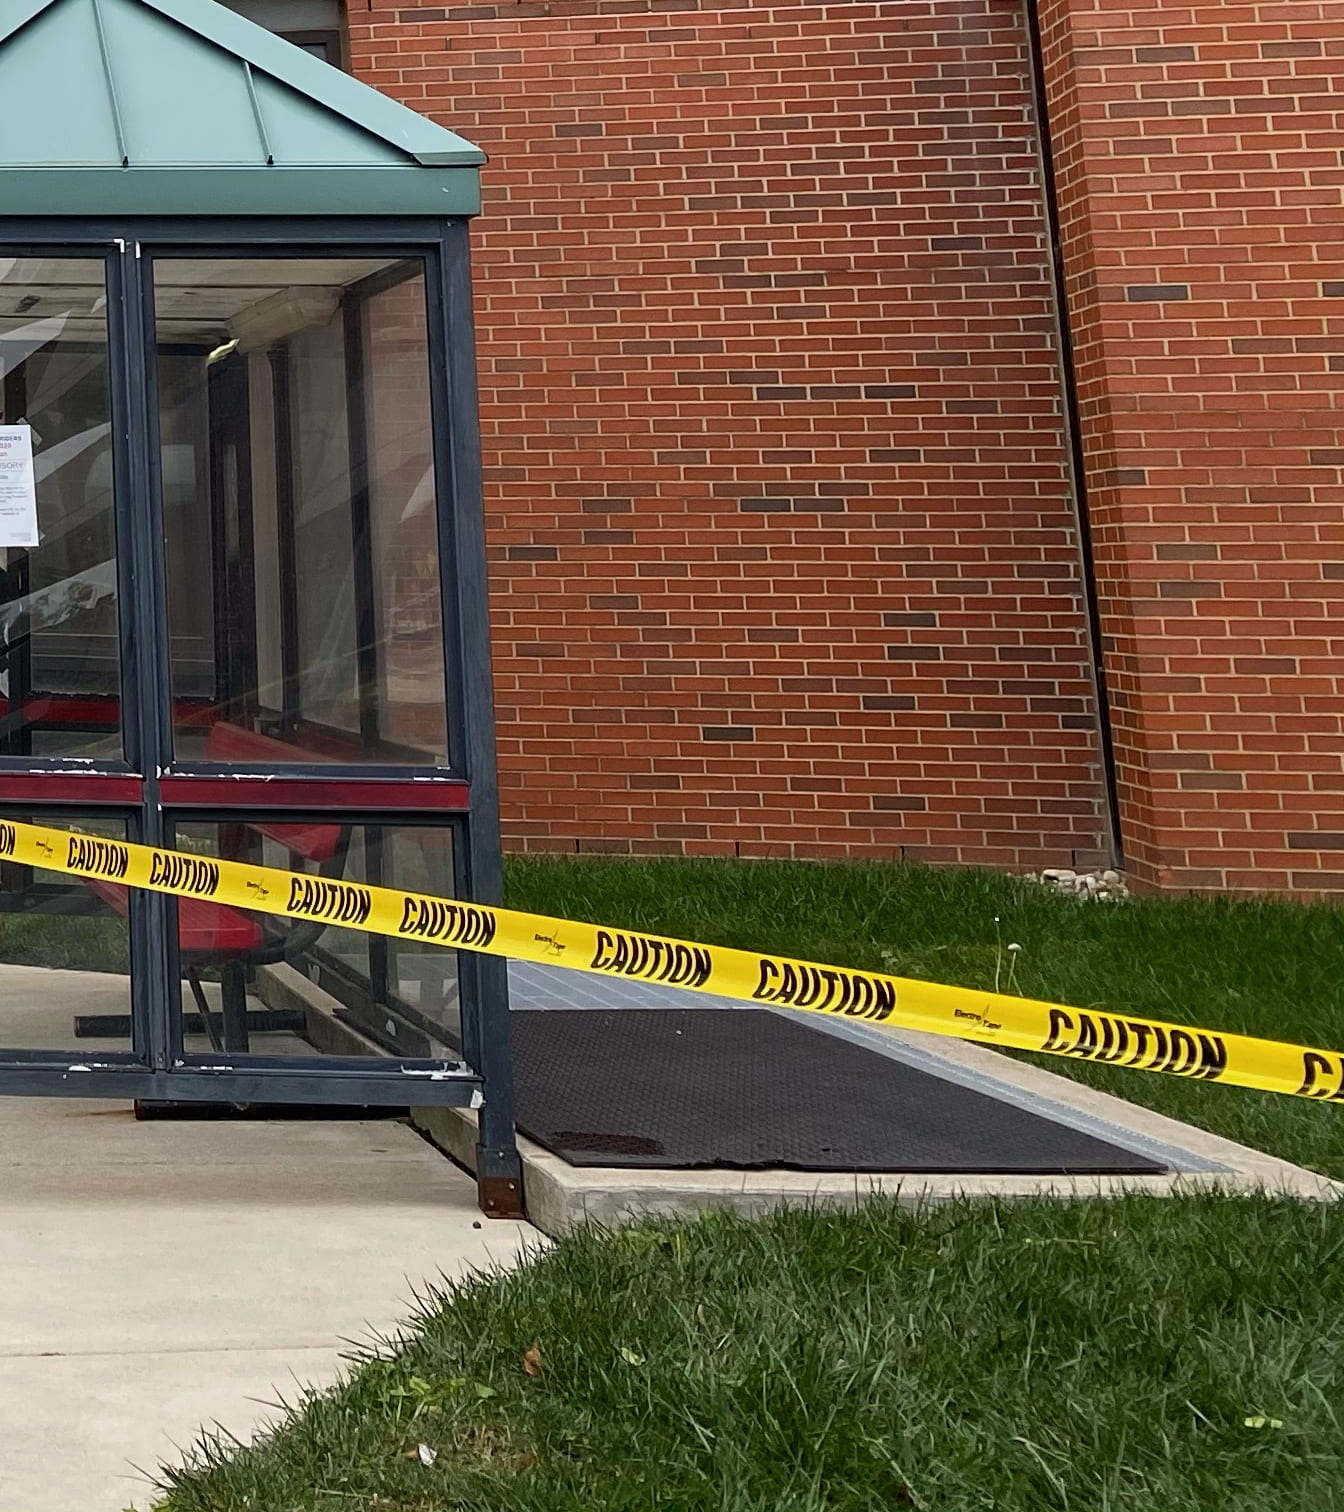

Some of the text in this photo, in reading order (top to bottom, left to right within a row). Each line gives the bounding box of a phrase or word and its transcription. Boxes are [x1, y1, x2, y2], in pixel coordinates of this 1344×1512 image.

[67, 837, 128, 878] CAUTION
[149, 852, 218, 895] CAUTION
[287, 877, 371, 924] CAUTION
[399, 897, 496, 947] CAUTION
[590, 931, 712, 987] CAUTION
[752, 959, 896, 1021] CAUTION
[1041, 1009, 1227, 1079] CAUTION
